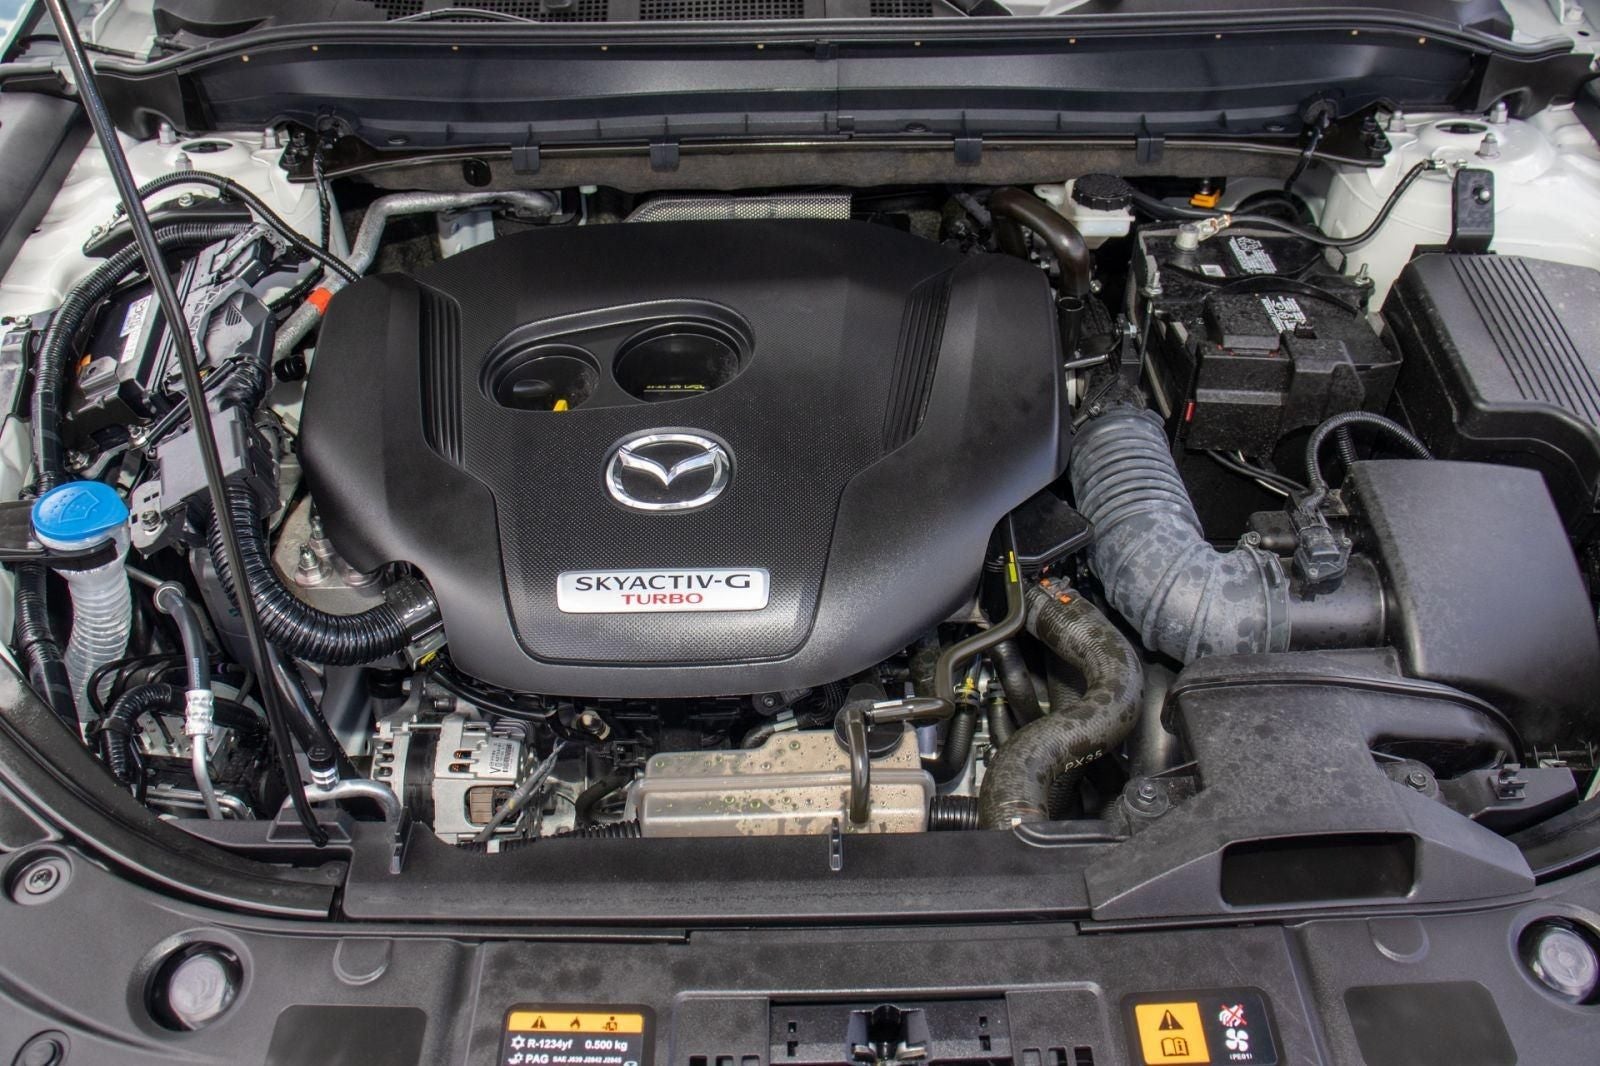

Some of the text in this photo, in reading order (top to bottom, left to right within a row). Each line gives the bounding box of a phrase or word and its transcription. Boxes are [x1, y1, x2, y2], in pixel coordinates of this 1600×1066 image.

[575, 574, 751, 592] SKYACTIV-G
[621, 592, 703, 606] TURBO
[527, 1038, 628, 1052] R-1234yf 0.500 kg
[525, 1054, 549, 1064] PAG
